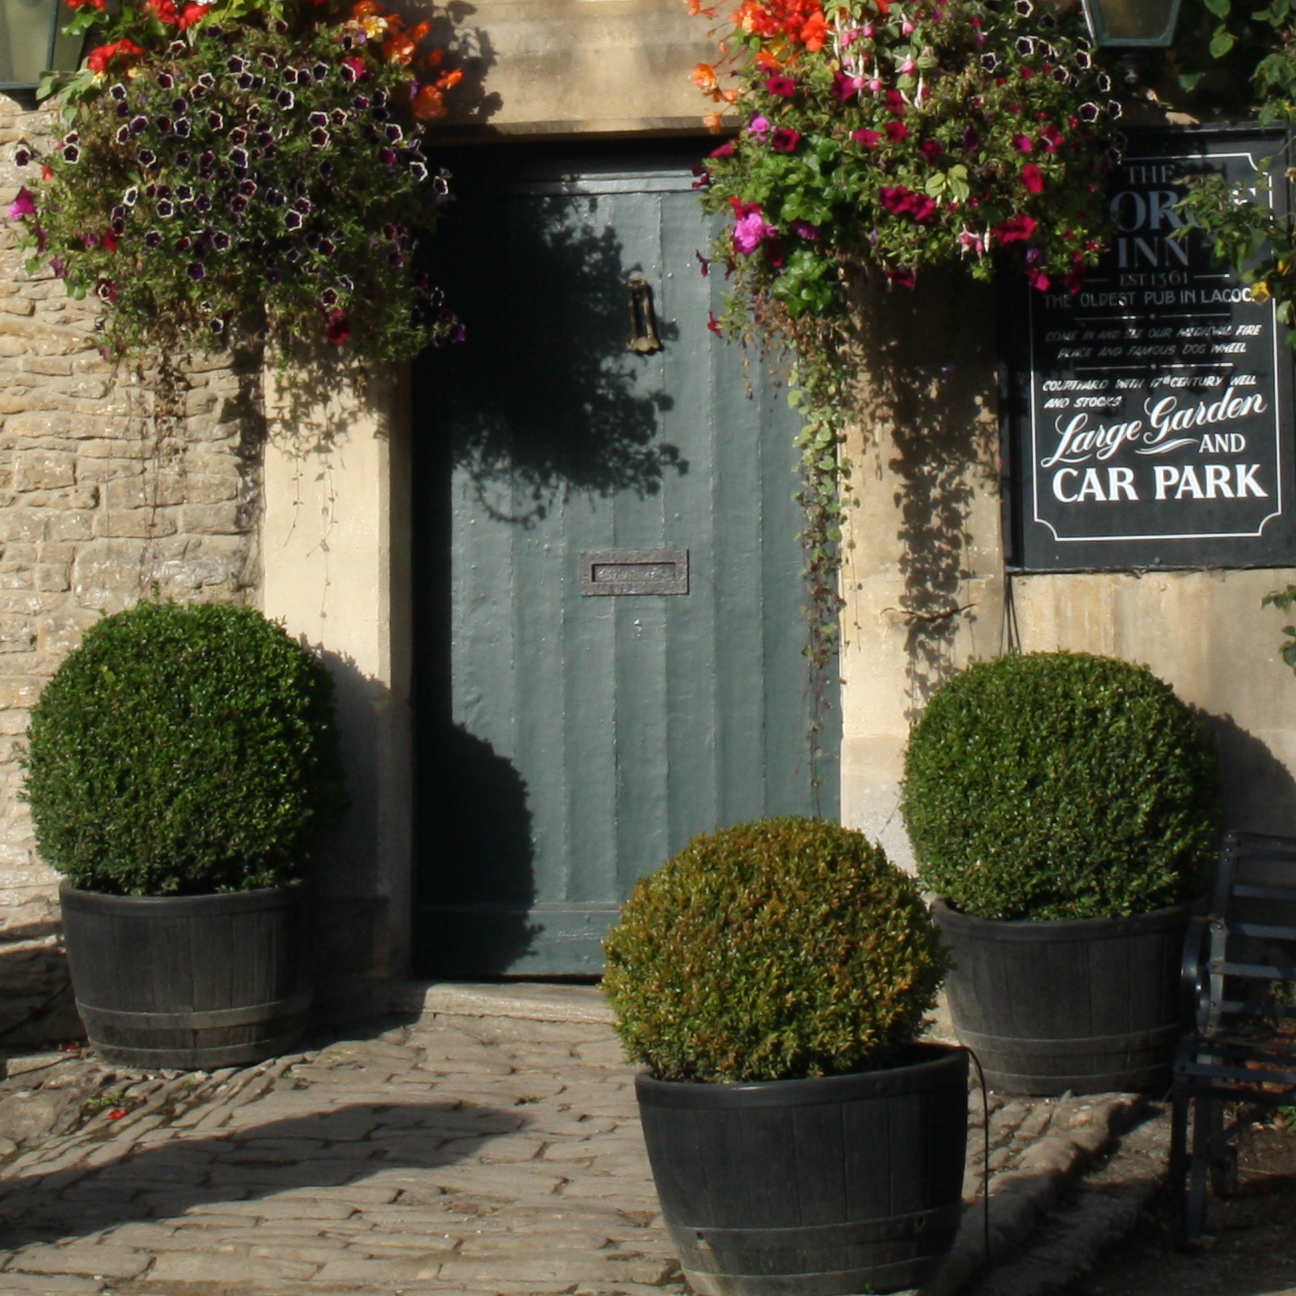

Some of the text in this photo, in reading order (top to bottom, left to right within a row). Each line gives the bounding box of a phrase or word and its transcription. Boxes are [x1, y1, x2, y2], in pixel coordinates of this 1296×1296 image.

[1123, 164, 1176, 184] THE
[1117, 235, 1190, 269] INN
[1119, 269, 1189, 288] EST 1361
[1043, 287, 1256, 309] THE OLDEST PUB IN LACOC
[1096, 329, 1120, 341] AND
[1147, 326, 1171, 339] OUR
[1234, 323, 1262, 337] FIRE
[1057, 341, 1247, 359] PLACE AND FAMOUS DOG WHEEL
[1042, 378, 1109, 393] COURTYARD
[1114, 377, 1145, 390] WITH
[1229, 374, 1257, 386] WELL
[1043, 395, 1123, 410] AND STOCKS
[1040, 386, 1268, 468] Large Garden
[1198, 433, 1247, 454] AND
[1051, 463, 1269, 503] CAR PARK
